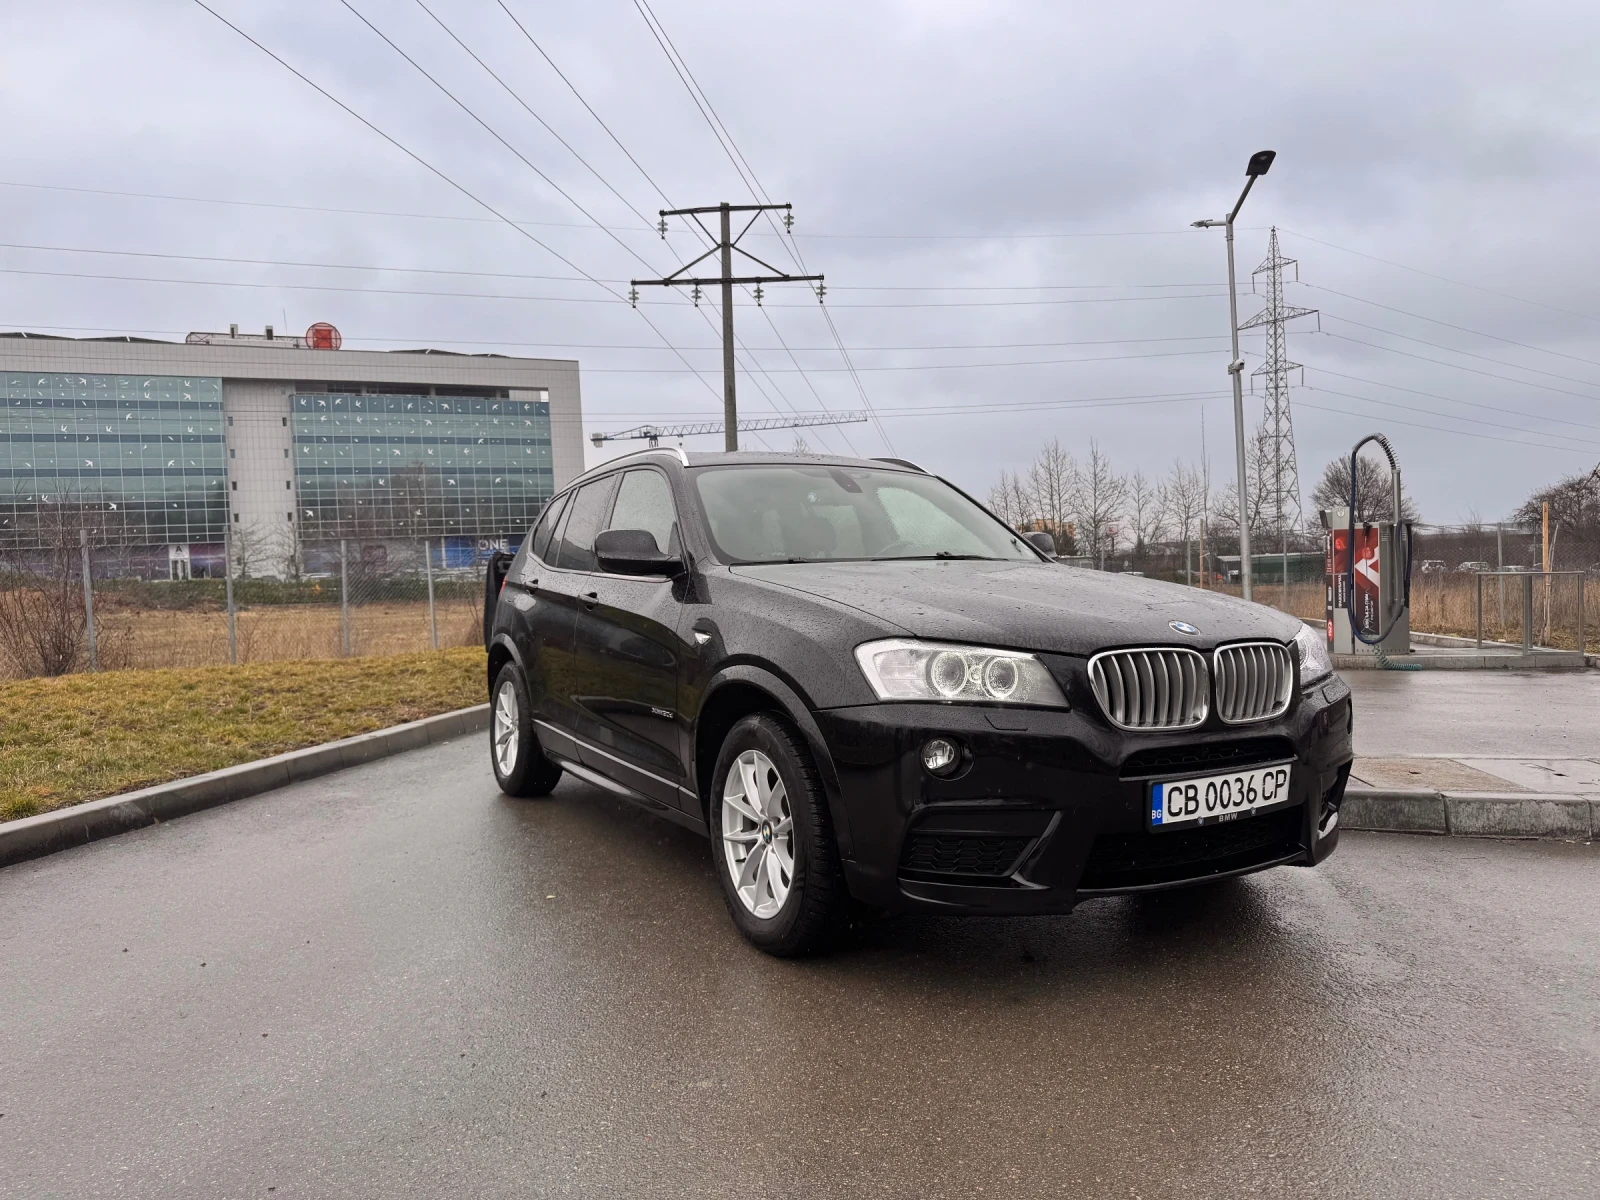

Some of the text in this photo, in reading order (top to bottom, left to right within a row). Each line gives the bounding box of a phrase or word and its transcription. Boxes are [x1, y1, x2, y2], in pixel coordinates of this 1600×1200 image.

[1167, 769, 1287, 817] CB 0036 CP
[1152, 809, 1162, 820] BG
[1218, 812, 1238, 823] BMW
